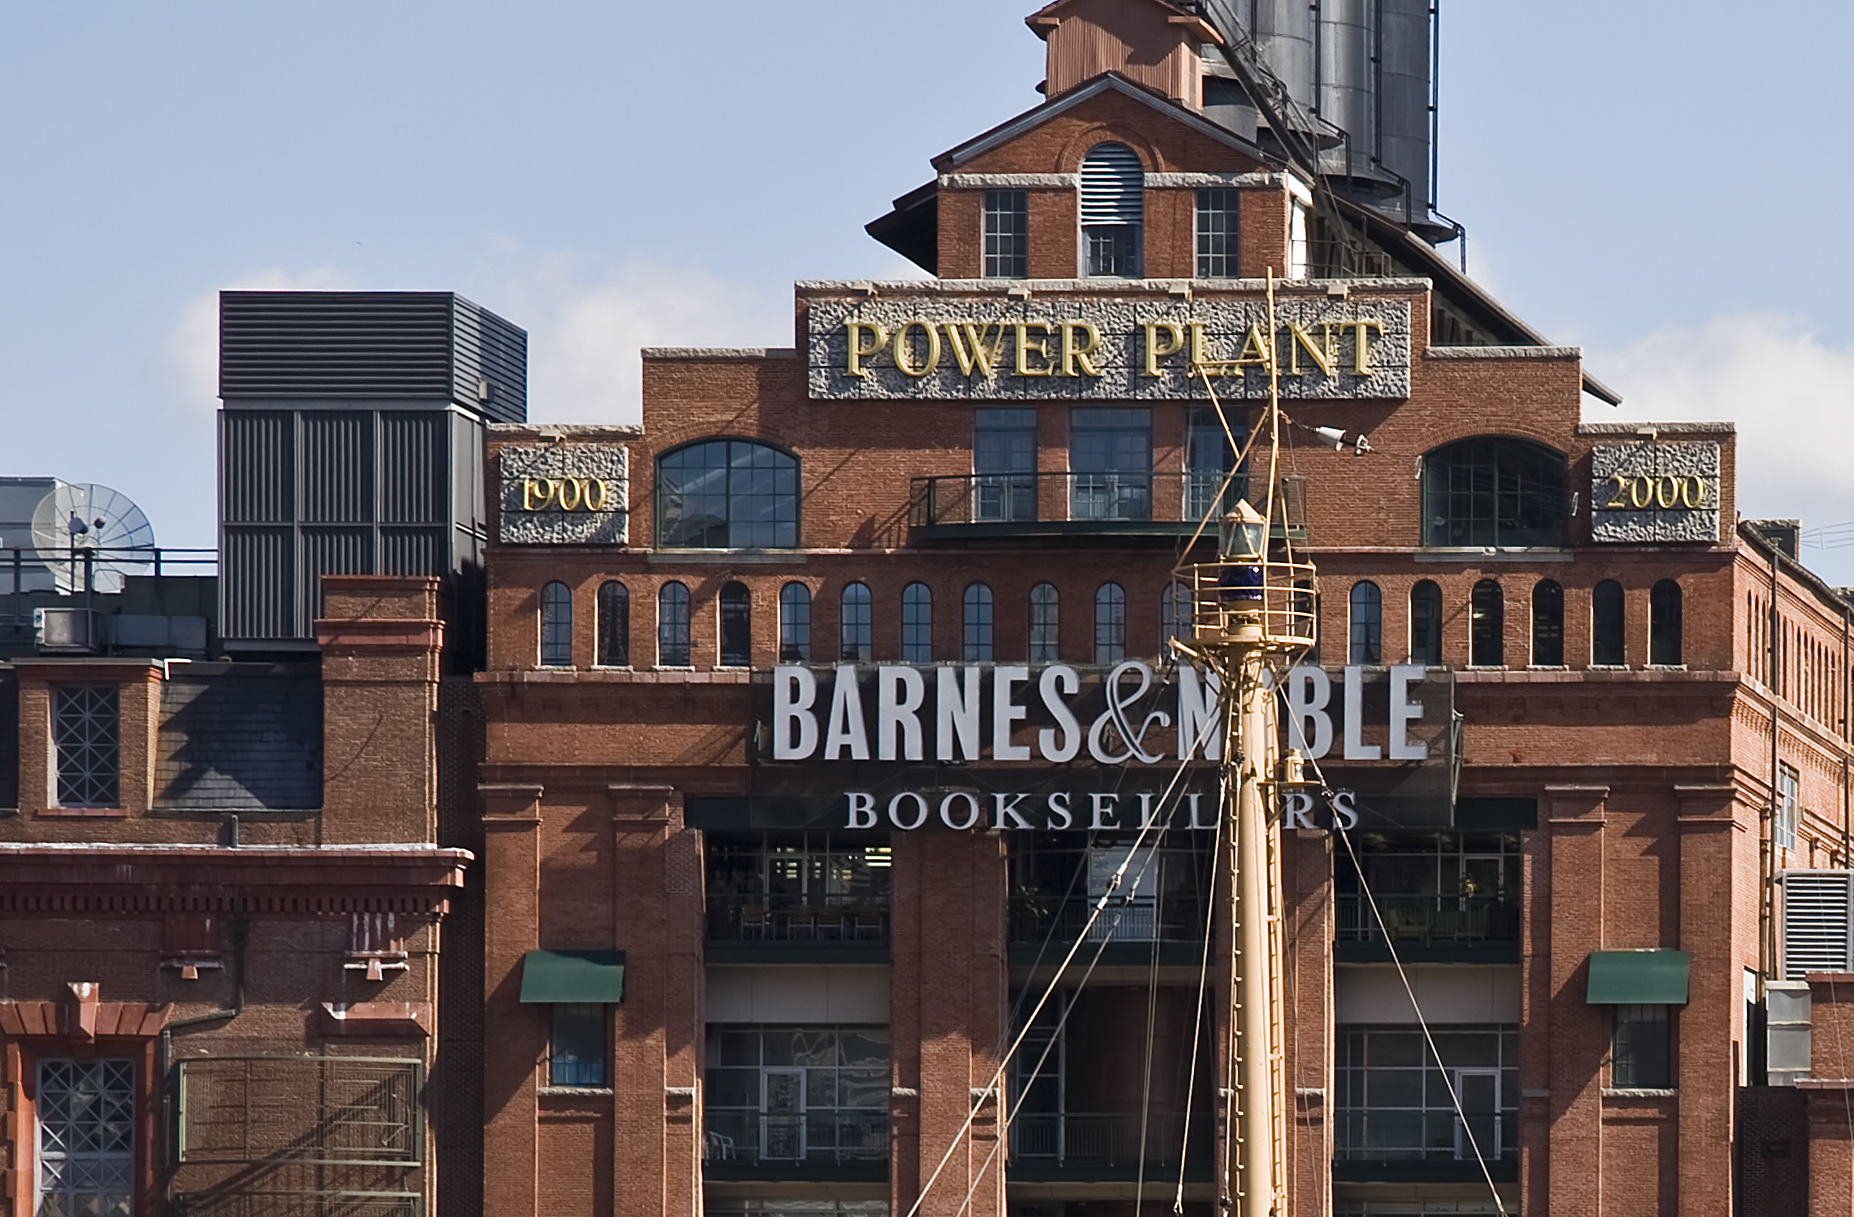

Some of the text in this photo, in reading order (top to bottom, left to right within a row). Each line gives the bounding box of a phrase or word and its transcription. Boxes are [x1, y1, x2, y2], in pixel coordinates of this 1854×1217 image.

[843, 318, 1384, 377] POWER PLANT
[523, 476, 606, 511] 1900
[1606, 473, 1704, 508] 2000
[773, 661, 1428, 765] BARNES & NBLE
[844, 791, 1358, 830] BOOKSELLRS
